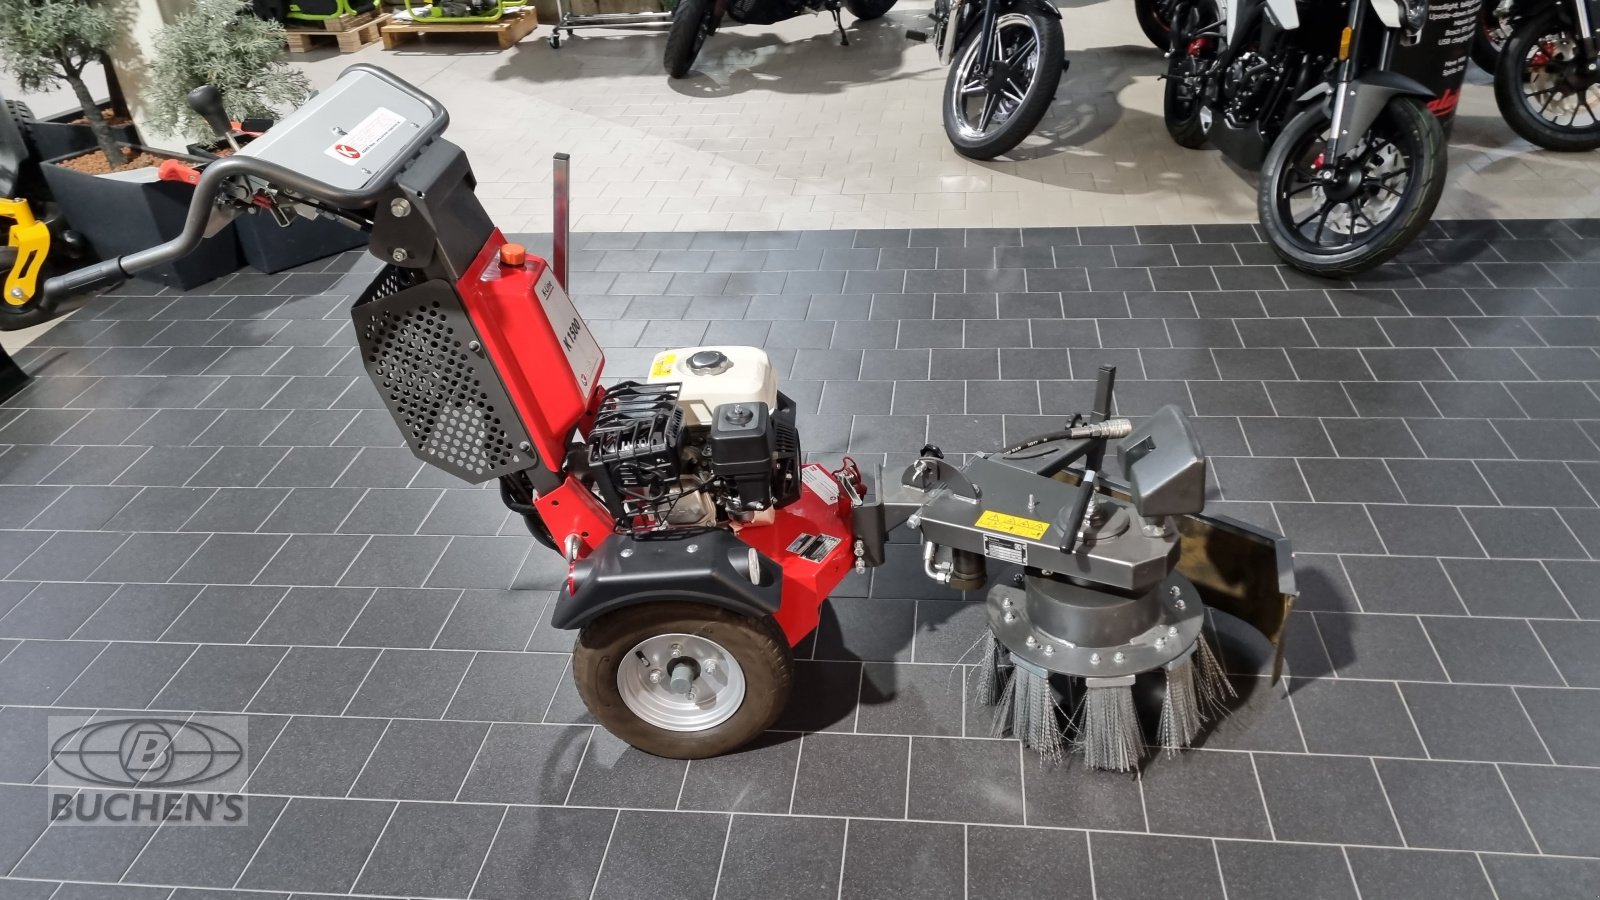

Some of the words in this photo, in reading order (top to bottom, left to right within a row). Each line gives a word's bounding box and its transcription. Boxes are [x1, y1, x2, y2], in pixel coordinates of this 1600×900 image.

[541, 281, 553, 297] K-Line
[567, 318, 581, 344] 1500
[563, 336, 573, 352] K
